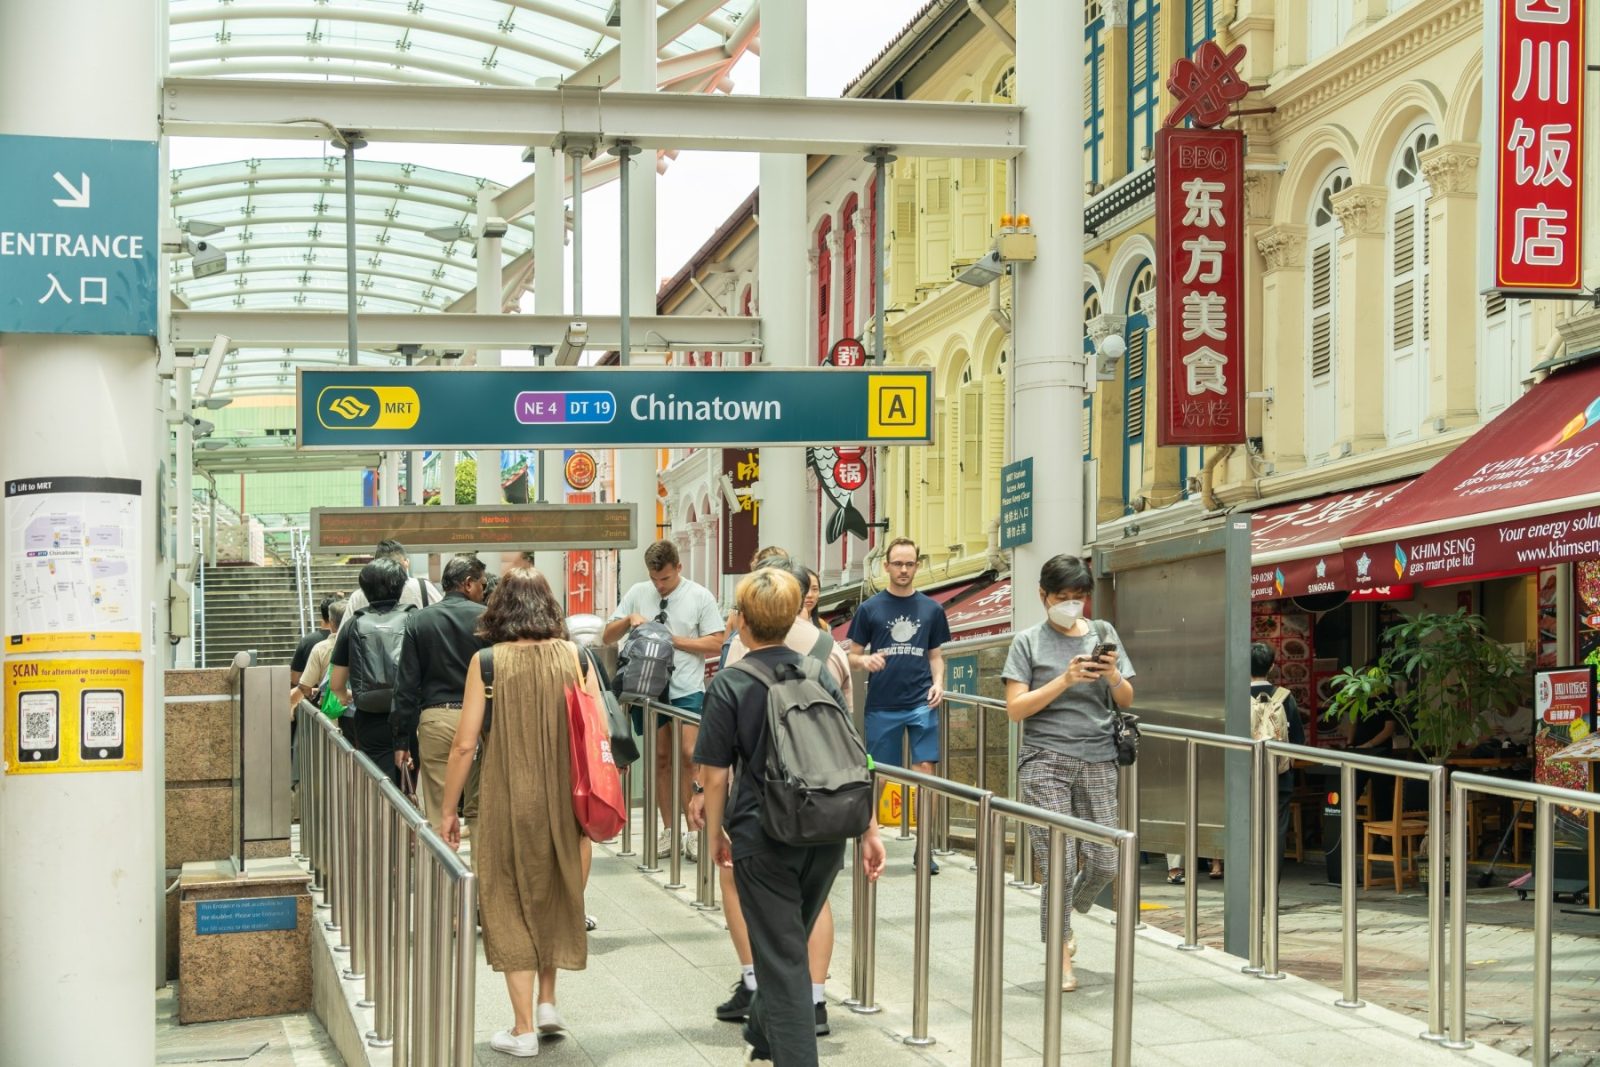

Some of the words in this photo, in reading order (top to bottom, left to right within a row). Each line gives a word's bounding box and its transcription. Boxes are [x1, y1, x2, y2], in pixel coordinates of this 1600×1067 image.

[1179, 145, 1228, 171] BBQ
[0, 231, 144, 259] ENTRANCE
[38, 272, 107, 305] 入口
[1181, 176, 1229, 396] 东方美食
[384, 401, 414, 414] MRT
[524, 401, 544, 415] NE
[547, 402, 558, 415] 4
[570, 401, 589, 415] DT
[593, 401, 611, 415] 19
[629, 393, 781, 421] Chinatown
[887, 394, 907, 419] A
[1472, 454, 1538, 477] KHIM
[1532, 442, 1599, 466] SENG
[838, 463, 861, 483] 锅
[17, 482, 28, 492] Lift
[28, 482, 36, 491] to
[36, 481, 53, 490] MRT
[1499, 526, 1526, 543] Your
[1527, 520, 1571, 539] energy
[1411, 542, 1441, 560] KHIM
[1443, 537, 1476, 556] SENG
[1516, 539, 1600, 563] www.khimsen
[1409, 562, 1424, 576] gas
[1426, 559, 1445, 571] mart
[1446, 557, 1461, 572] pte
[1462, 552, 1474, 566] ltd
[1307, 581, 1335, 593] SINGGAS
[12, 663, 39, 678] SCAN
[41, 668, 51, 676] for
[52, 667, 89, 676] alternative
[90, 667, 109, 675] travel
[109, 667, 131, 677] options
[953, 665, 964, 679] EXIT
